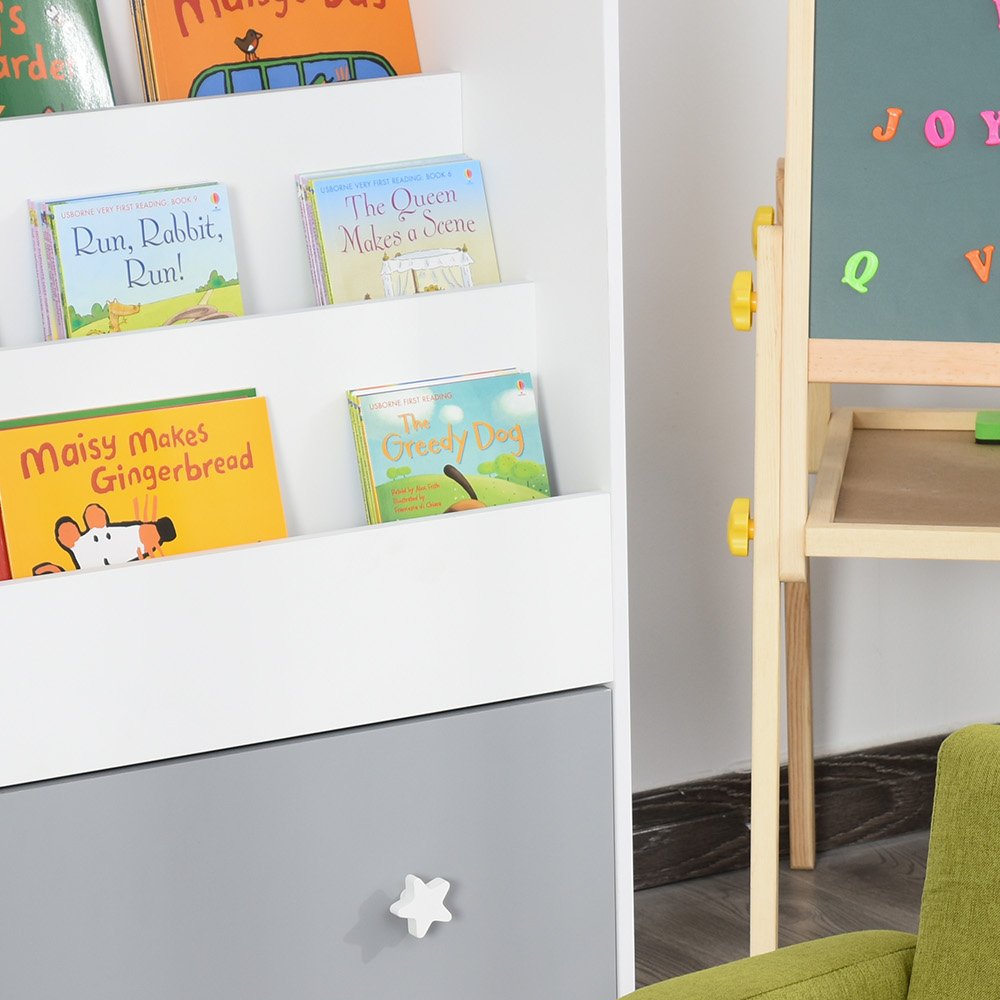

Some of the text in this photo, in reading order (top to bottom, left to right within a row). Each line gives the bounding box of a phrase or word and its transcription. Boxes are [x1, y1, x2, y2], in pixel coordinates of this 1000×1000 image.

[320, 182, 353, 194] USBORNE
[355, 180, 371, 189] VERY
[373, 178, 391, 187] FIRST
[426, 172, 446, 180] BOOK
[61, 207, 95, 219] USBORNE
[97, 206, 114, 215] VERY
[116, 203, 133, 212] FIRST
[171, 196, 192, 205] BOOK
[344, 187, 457, 222] The Queen
[71, 210, 223, 257] Run, Rabbit,
[338, 208, 476, 254] Makes a Scene
[125, 252, 184, 289] Run!
[841, 250, 879, 293] Q
[369, 392, 453, 410] USBORNE FIRST READING
[382, 421, 525, 465] Greedy Dog
[397, 412, 431, 435] The
[20, 423, 209, 479] Maisy Makes
[91, 441, 254, 494] Gingerbread
